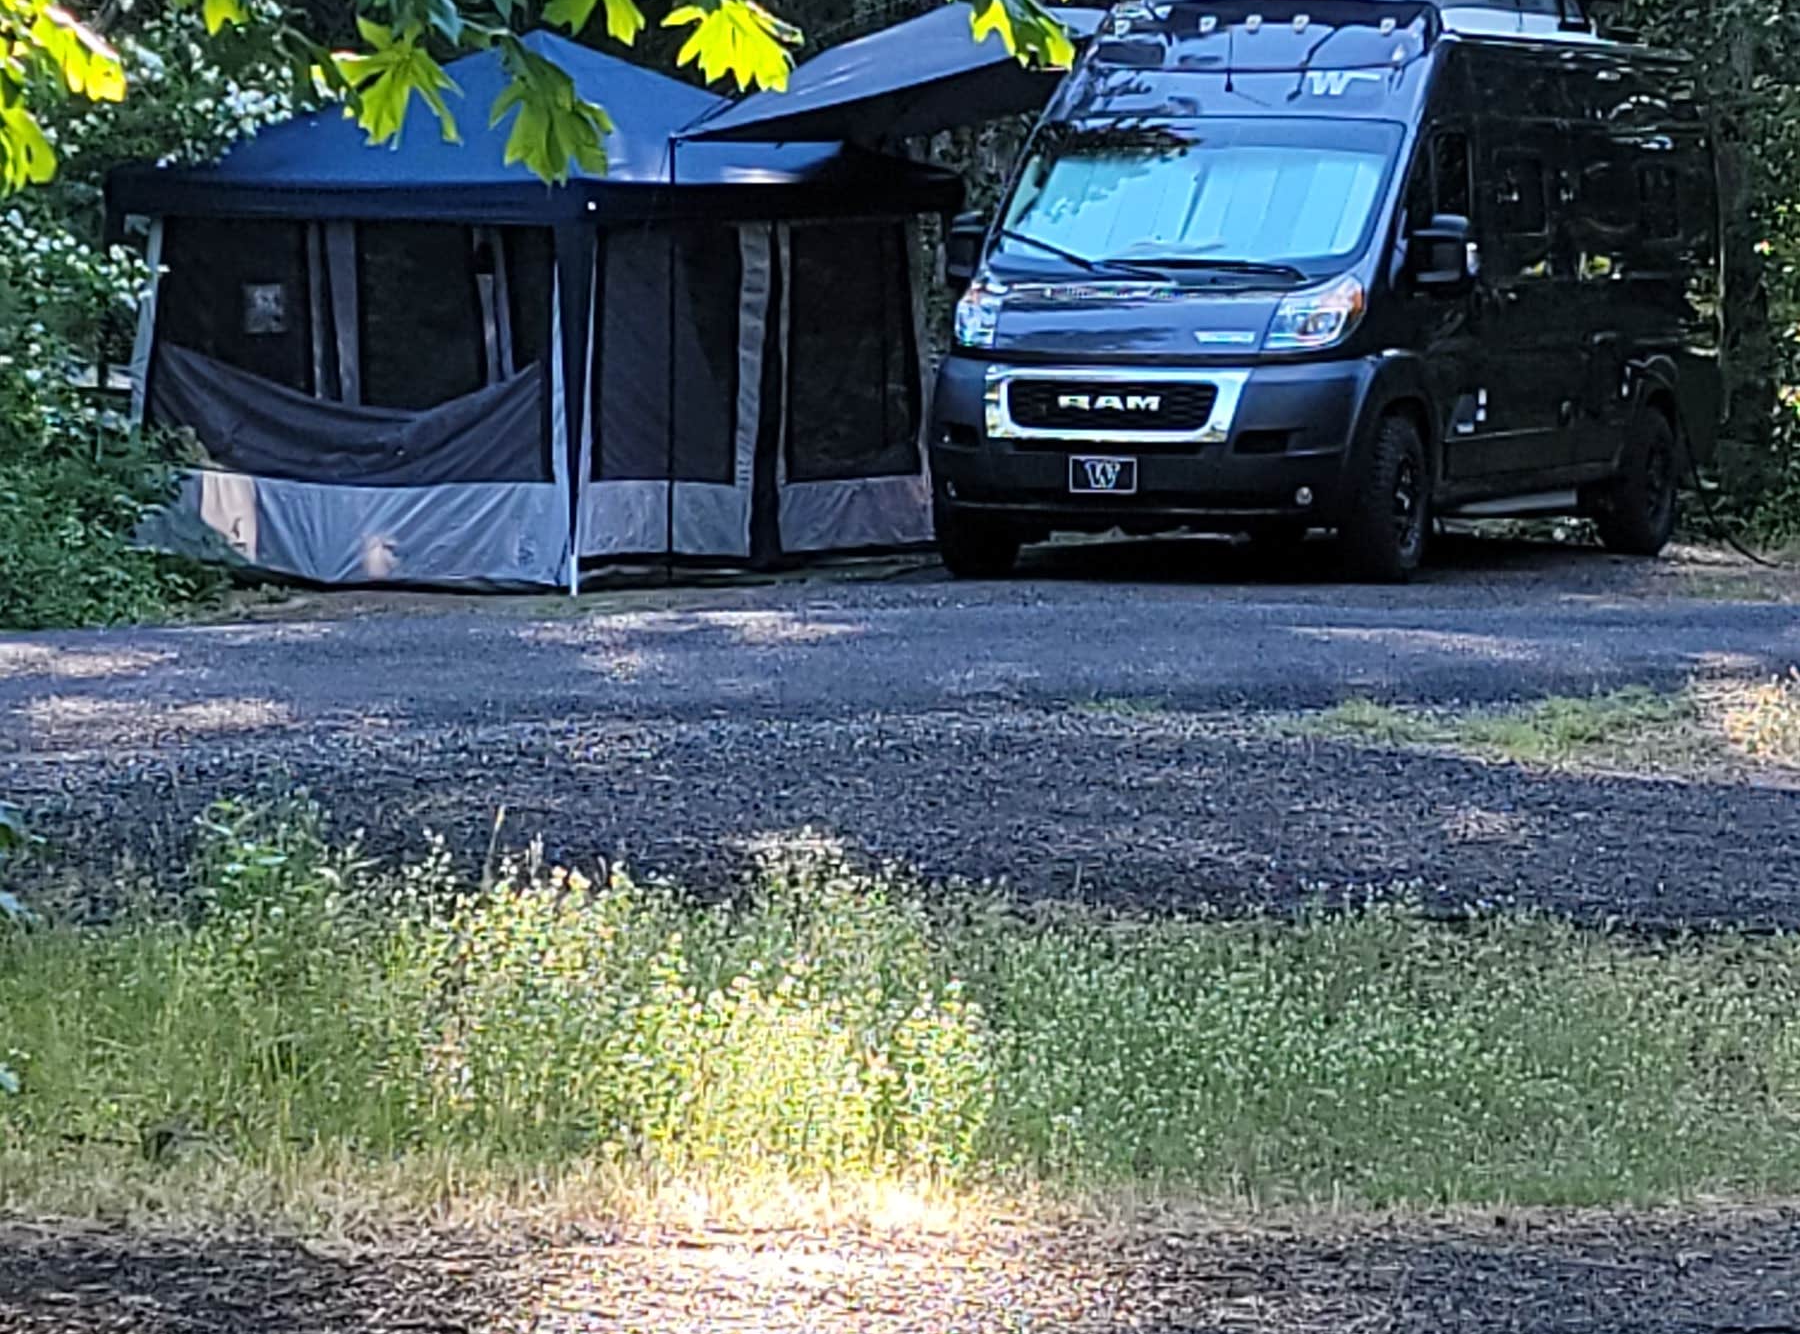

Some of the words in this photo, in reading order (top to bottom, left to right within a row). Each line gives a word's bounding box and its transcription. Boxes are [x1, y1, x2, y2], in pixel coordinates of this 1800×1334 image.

[1307, 71, 1380, 95] W
[1058, 395, 1160, 411] RAM
[1084, 460, 1121, 488] W
